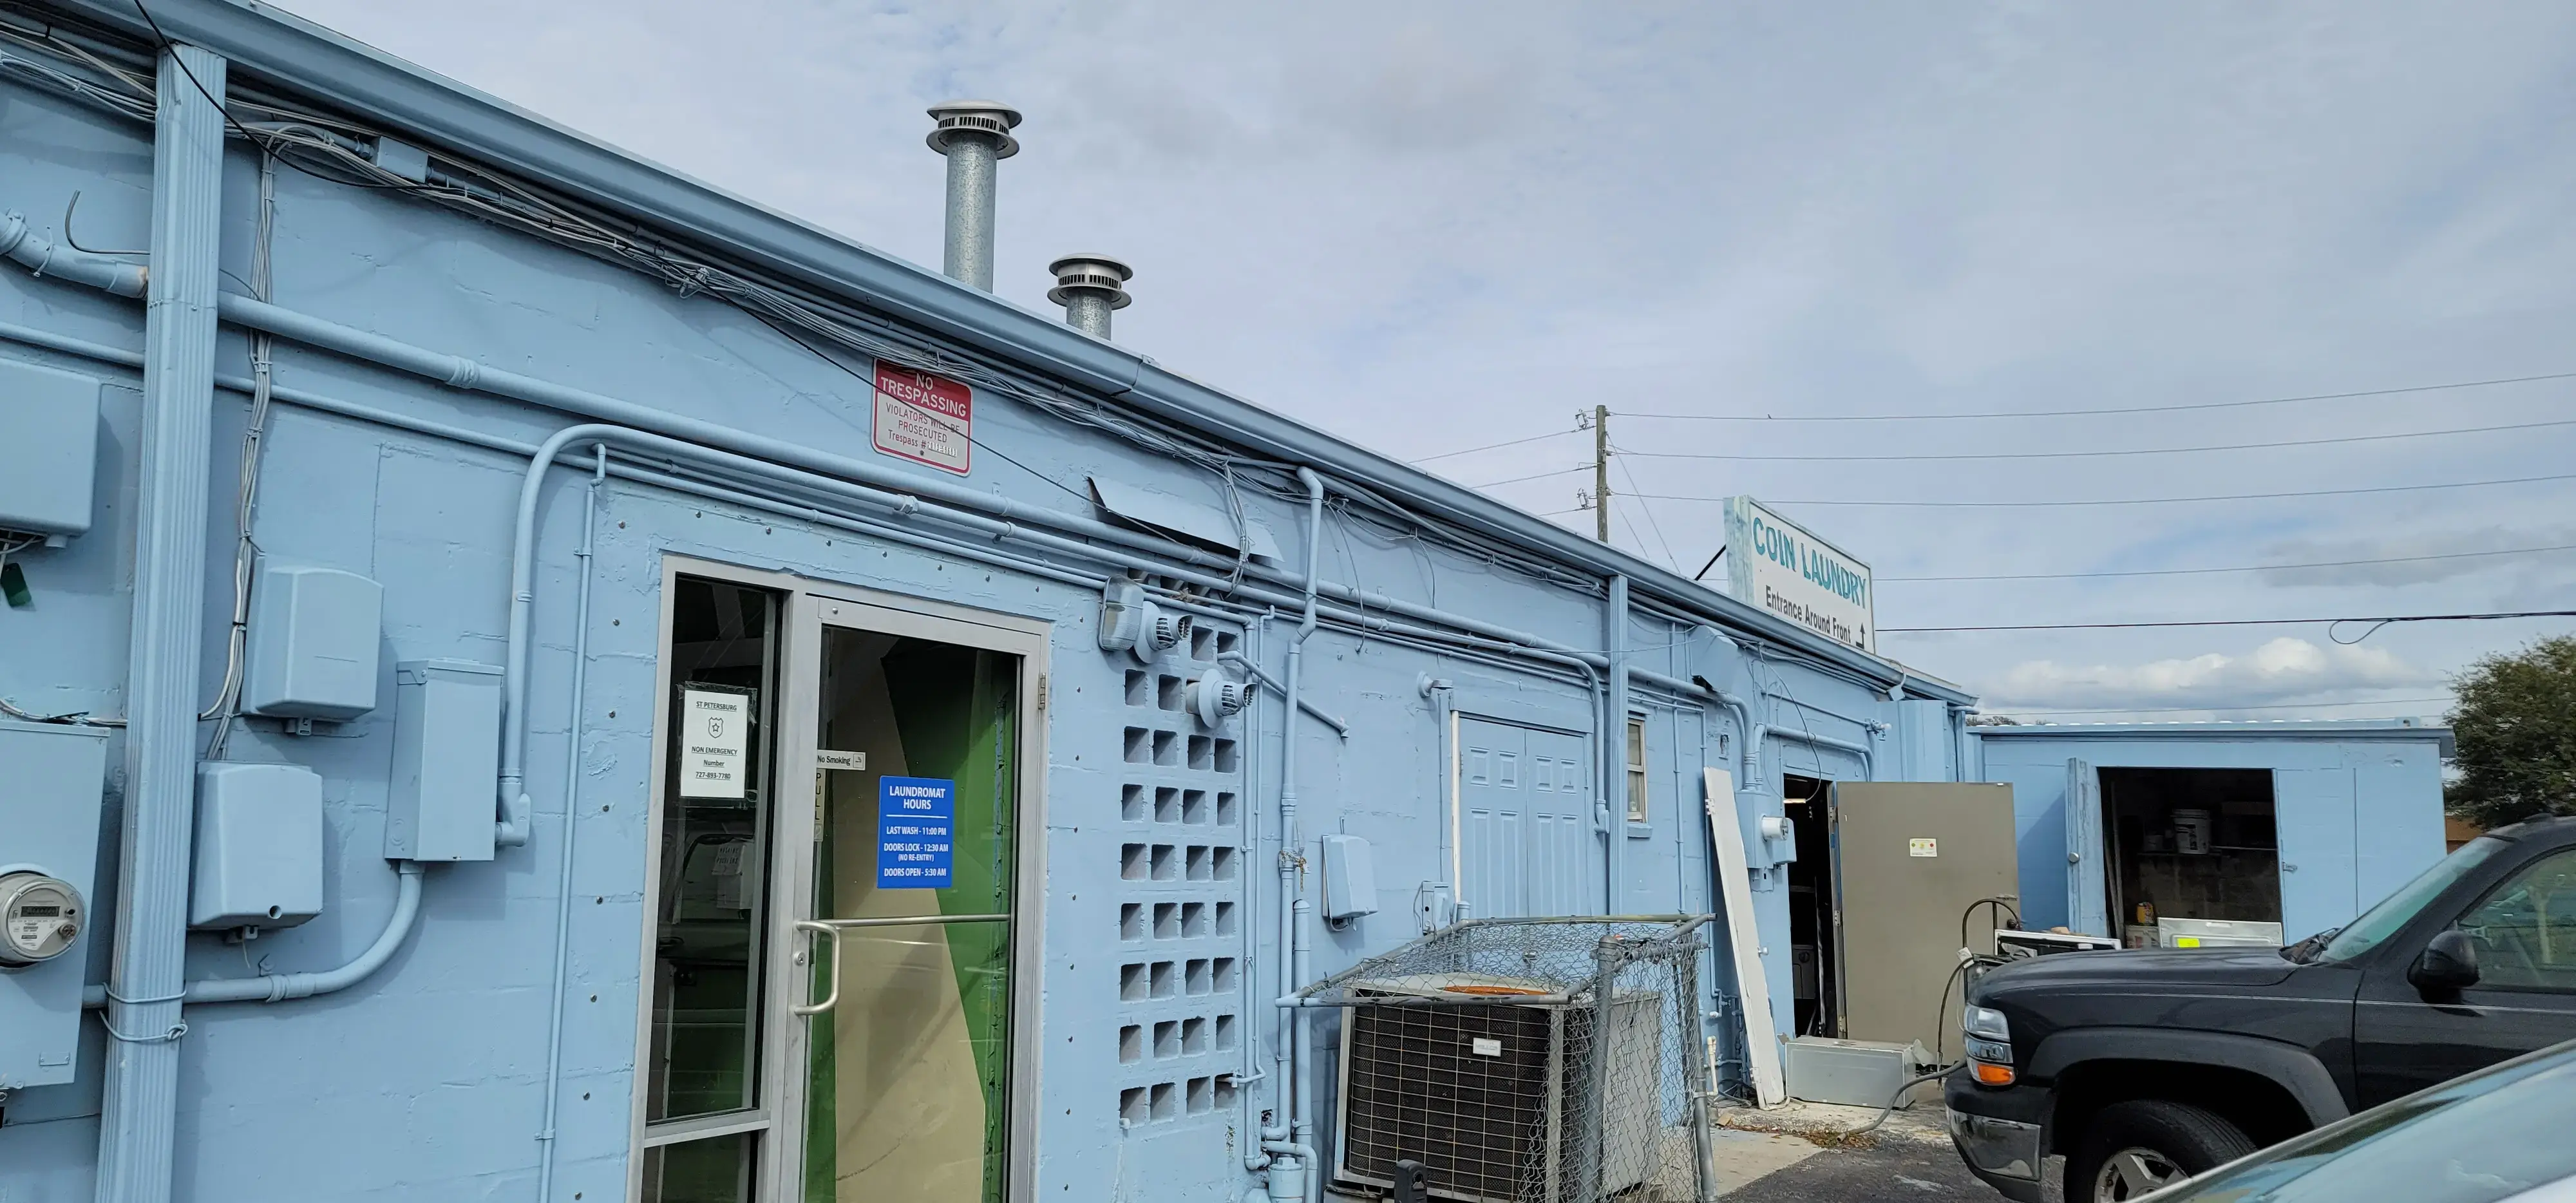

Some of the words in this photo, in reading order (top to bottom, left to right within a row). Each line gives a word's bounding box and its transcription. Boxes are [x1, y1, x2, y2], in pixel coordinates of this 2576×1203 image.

[916, 373, 933, 390] NO
[881, 377, 966, 417] TRESPASSING
[886, 403, 928, 424] VIOLATORS
[931, 417, 948, 431] WILL
[951, 423, 960, 433] BE
[898, 420, 947, 443] PROSECUTED
[888, 429, 918, 447] Trespass
[1753, 516, 1797, 573] COIN
[1801, 542, 1866, 609] LAUNDRY
[1766, 584, 1803, 621] Entrance
[1805, 604, 1830, 634] Around
[1833, 616, 1851, 643] Front
[704, 701, 737, 711] PETERSBURG
[705, 747, 737, 755] EMERGENCY
[817, 755, 826, 763] No
[826, 755, 851, 766] Smoking
[889, 786, 945, 799] LAUNDROMAT
[904, 799, 932, 810] HOURS
[886, 826, 902, 835] LAST
[902, 826, 918, 835] WASH
[922, 827, 938, 835] 11:00
[938, 828, 947, 836] PM
[884, 843, 904, 851] DOORS
[905, 843, 920, 851] LOCK
[923, 844, 938, 852] 12:30
[939, 844, 949, 852] AM
[908, 854, 934, 862] RE-ENTRY)
[884, 868, 905, 876] DOORS
[905, 868, 921, 876] OPEN
[925, 868, 936, 876] 5:30
[936, 868, 947, 876] AM
